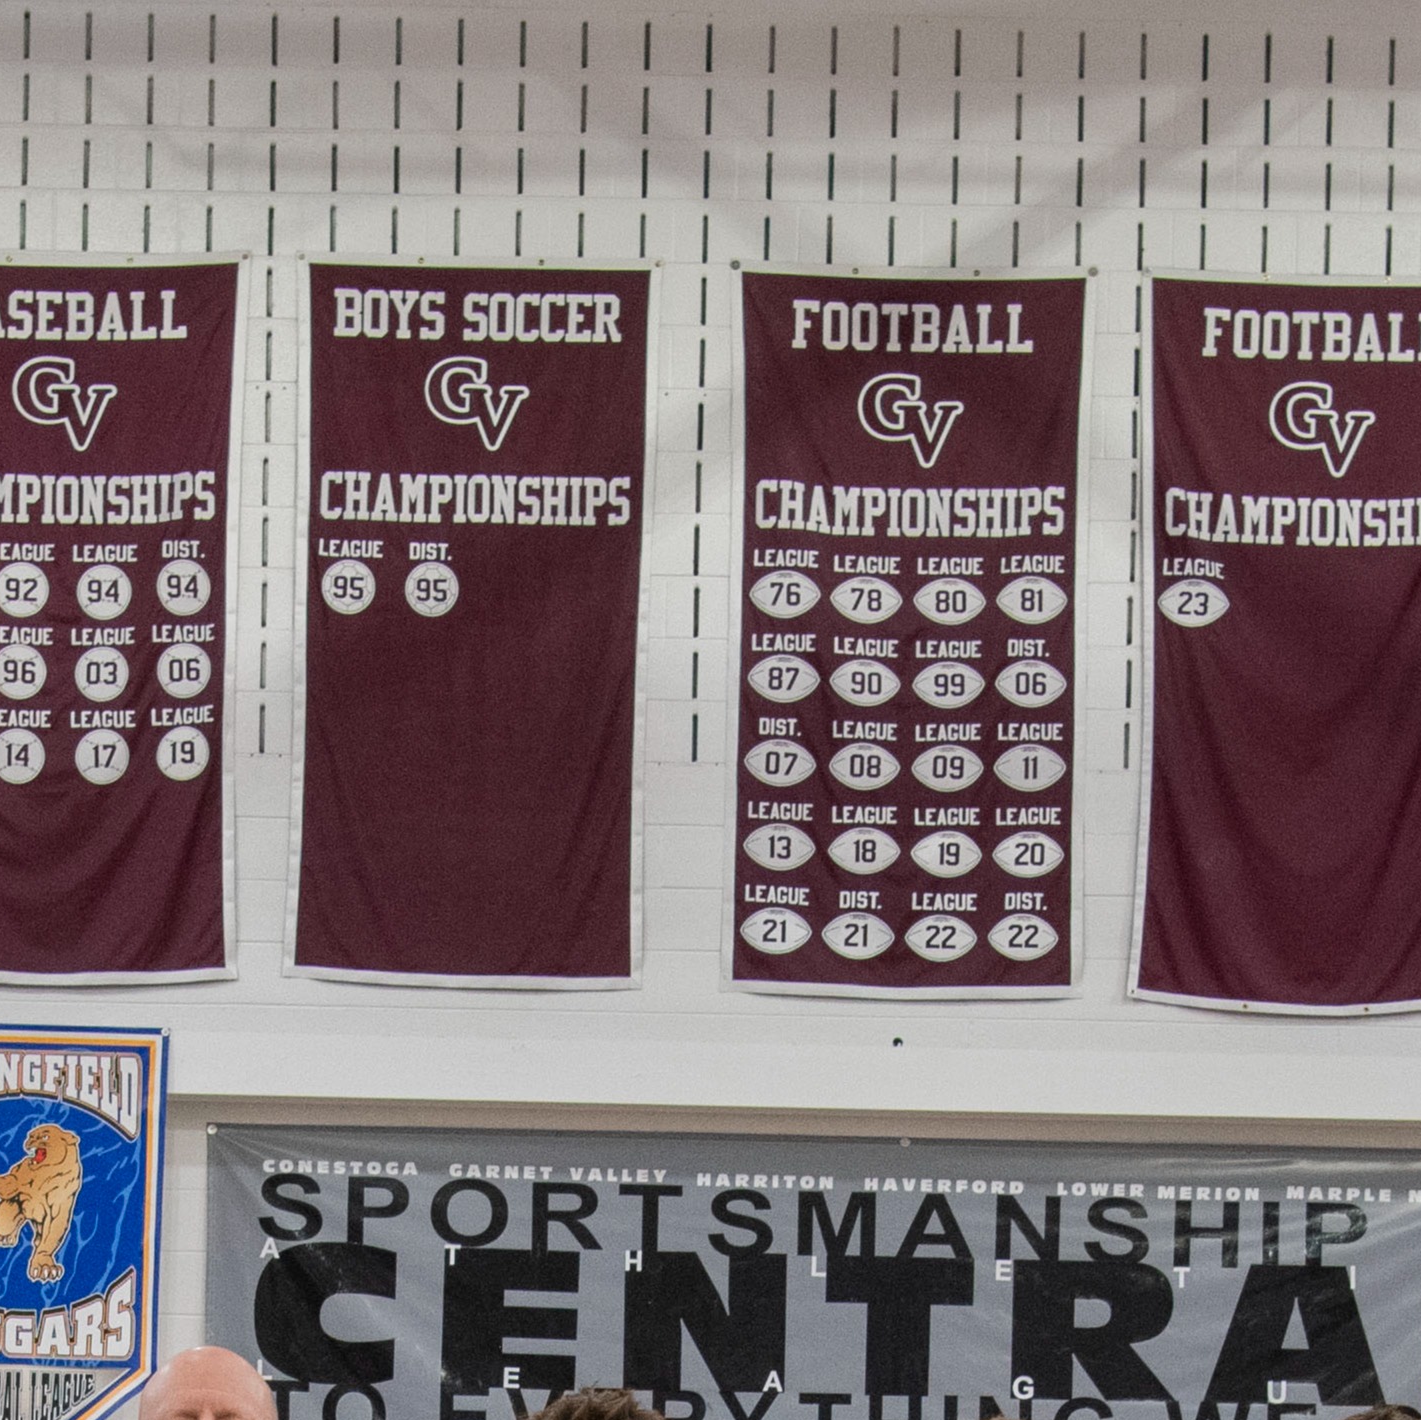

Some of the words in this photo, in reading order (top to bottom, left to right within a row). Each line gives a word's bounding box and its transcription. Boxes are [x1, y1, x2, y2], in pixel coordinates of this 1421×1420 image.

[333, 288, 445, 340] BOYS
[463, 292, 622, 342] SOCCER
[792, 299, 1033, 353] FOOTBALL
[12, 356, 117, 451] GV
[425, 356, 529, 451] GV
[858, 373, 963, 468] GV
[1269, 381, 1375, 478] GV
[320, 471, 630, 526] CHAMPIONSHIPS
[755, 479, 1065, 538] CHAMPIONSHIPS
[73, 544, 138, 562] LEAGUE
[162, 541, 205, 558] DIST.
[318, 538, 383, 558] LEAGUE
[409, 542, 452, 561] DIST.
[753, 549, 819, 568] LEAGUE
[833, 555, 900, 574] LEAGUE
[918, 557, 983, 575] LEAGUE
[1001, 555, 1064, 573] LEAGUE
[1162, 558, 1224, 579] LEAGUE
[5, 578, 38, 601] 92
[87, 580, 119, 603] 94
[167, 574, 198, 598] 94
[333, 576, 364, 600] 95
[416, 578, 448, 602] 95
[770, 582, 801, 606] 76
[850, 588, 882, 612] 78
[935, 591, 967, 613] 80
[1021, 589, 1044, 612] 81
[1178, 592, 1209, 616] 23
[263, 1159, 419, 1176] CONESTOGA
[449, 1163, 554, 1181] GARNET
[570, 1166, 668, 1183] VALLEY
[696, 1172, 835, 1190] HARRITON
[863, 1176, 1025, 1195] HAVERFORD
[1056, 1181, 1145, 1198] LOWER
[1157, 1185, 1260, 1201] MERION
[1286, 1185, 1392, 1203] MARPLE
[258, 1172, 1368, 1268] SPORTSMANSHIP
